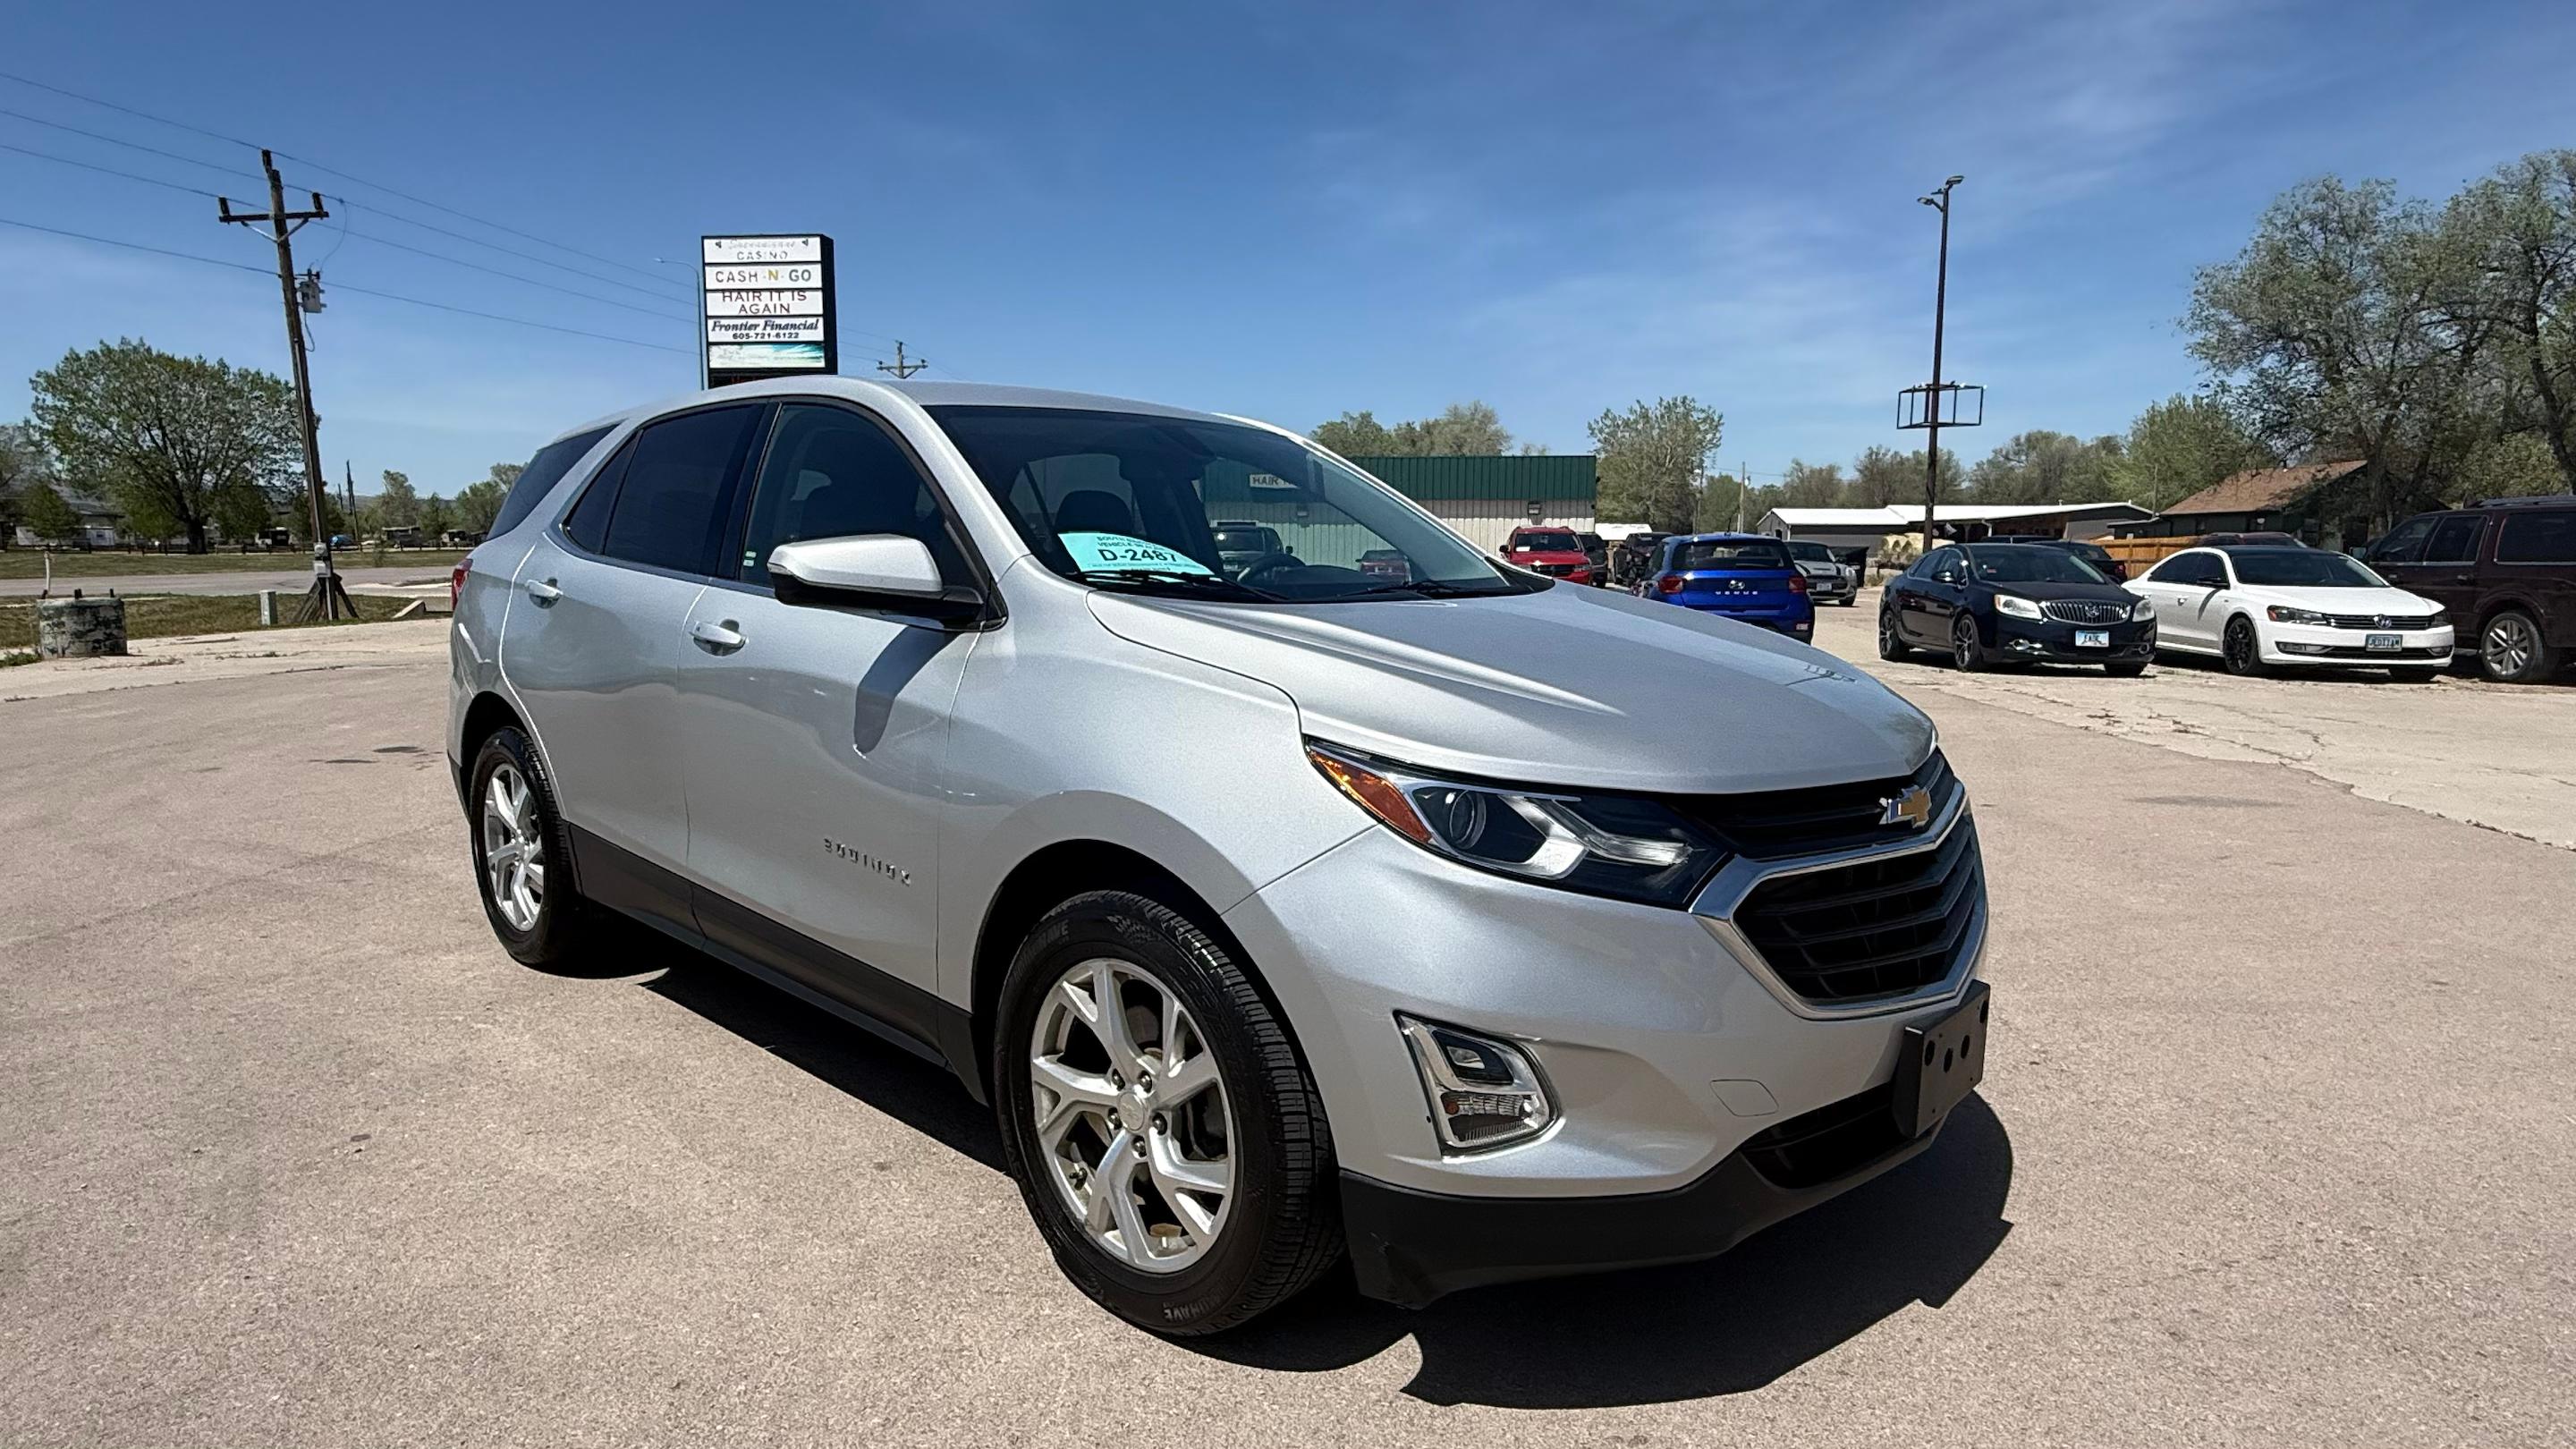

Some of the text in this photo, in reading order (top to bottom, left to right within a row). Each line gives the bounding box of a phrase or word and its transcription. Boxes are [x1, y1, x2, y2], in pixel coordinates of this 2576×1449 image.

[736, 250, 788, 260] CASINO
[716, 270, 758, 283] CASH
[788, 268, 811, 282] GO
[723, 289, 807, 302] HAIR IT IS
[738, 303, 790, 314] AGAIN
[711, 318, 819, 332] Frontier Financial
[1252, 476, 1279, 486] HAIR
[1097, 548, 1178, 563] D-2487
[824, 837, 911, 887] EQUINOX
